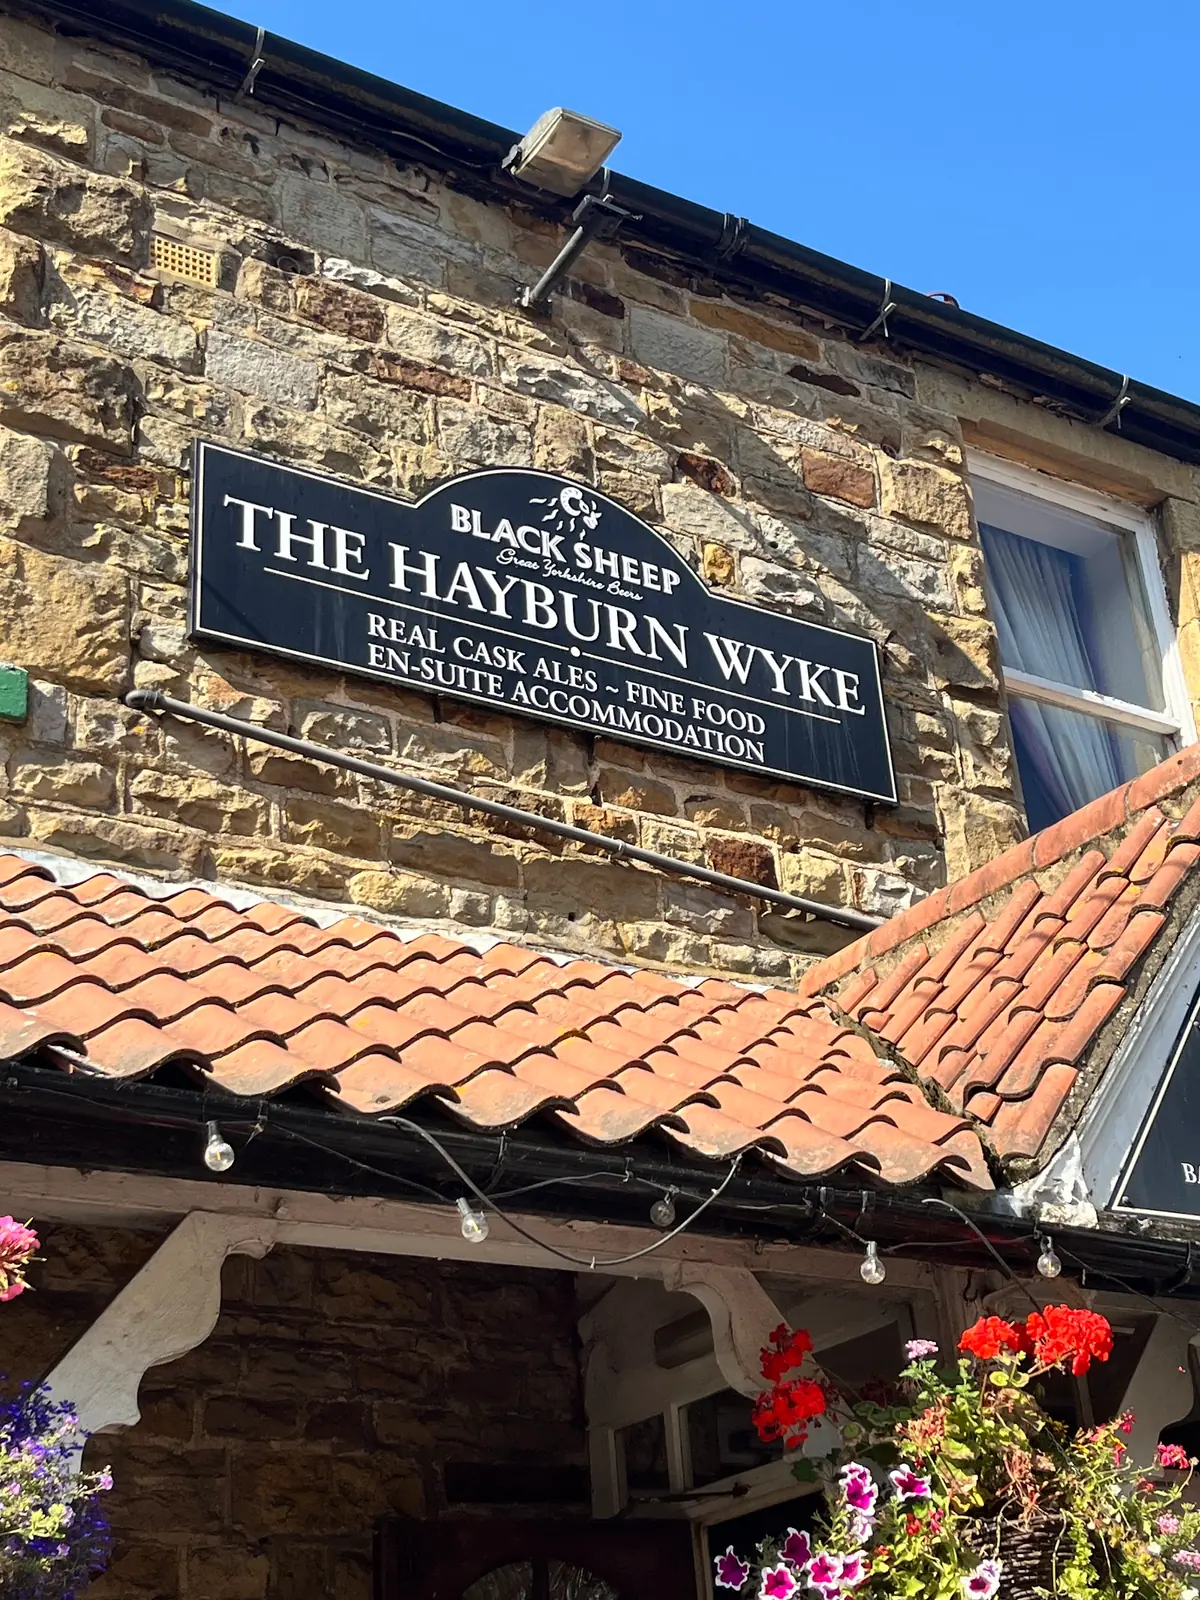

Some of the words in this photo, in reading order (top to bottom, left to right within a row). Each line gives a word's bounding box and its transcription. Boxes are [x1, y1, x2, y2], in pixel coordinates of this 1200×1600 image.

[450, 503, 568, 563] BLACK
[573, 542, 681, 595] SHEEP
[496, 548, 540, 570] Great
[541, 558, 606, 591] Yorkshire
[605, 581, 644, 601] Beers
[223, 493, 370, 581] THE
[387, 541, 690, 669] HAYBURN
[702, 631, 866, 716] WYKE
[367, 612, 446, 654] REAL
[453, 636, 526, 675] CASK
[532, 657, 598, 693] ALES
[625, 680, 687, 716] FINE
[691, 697, 766, 735] FOOD
[367, 642, 505, 698] EN-SUITE
[510, 680, 765, 763] ACCOMMODATION
[1180, 1162, 1200, 1185] B
